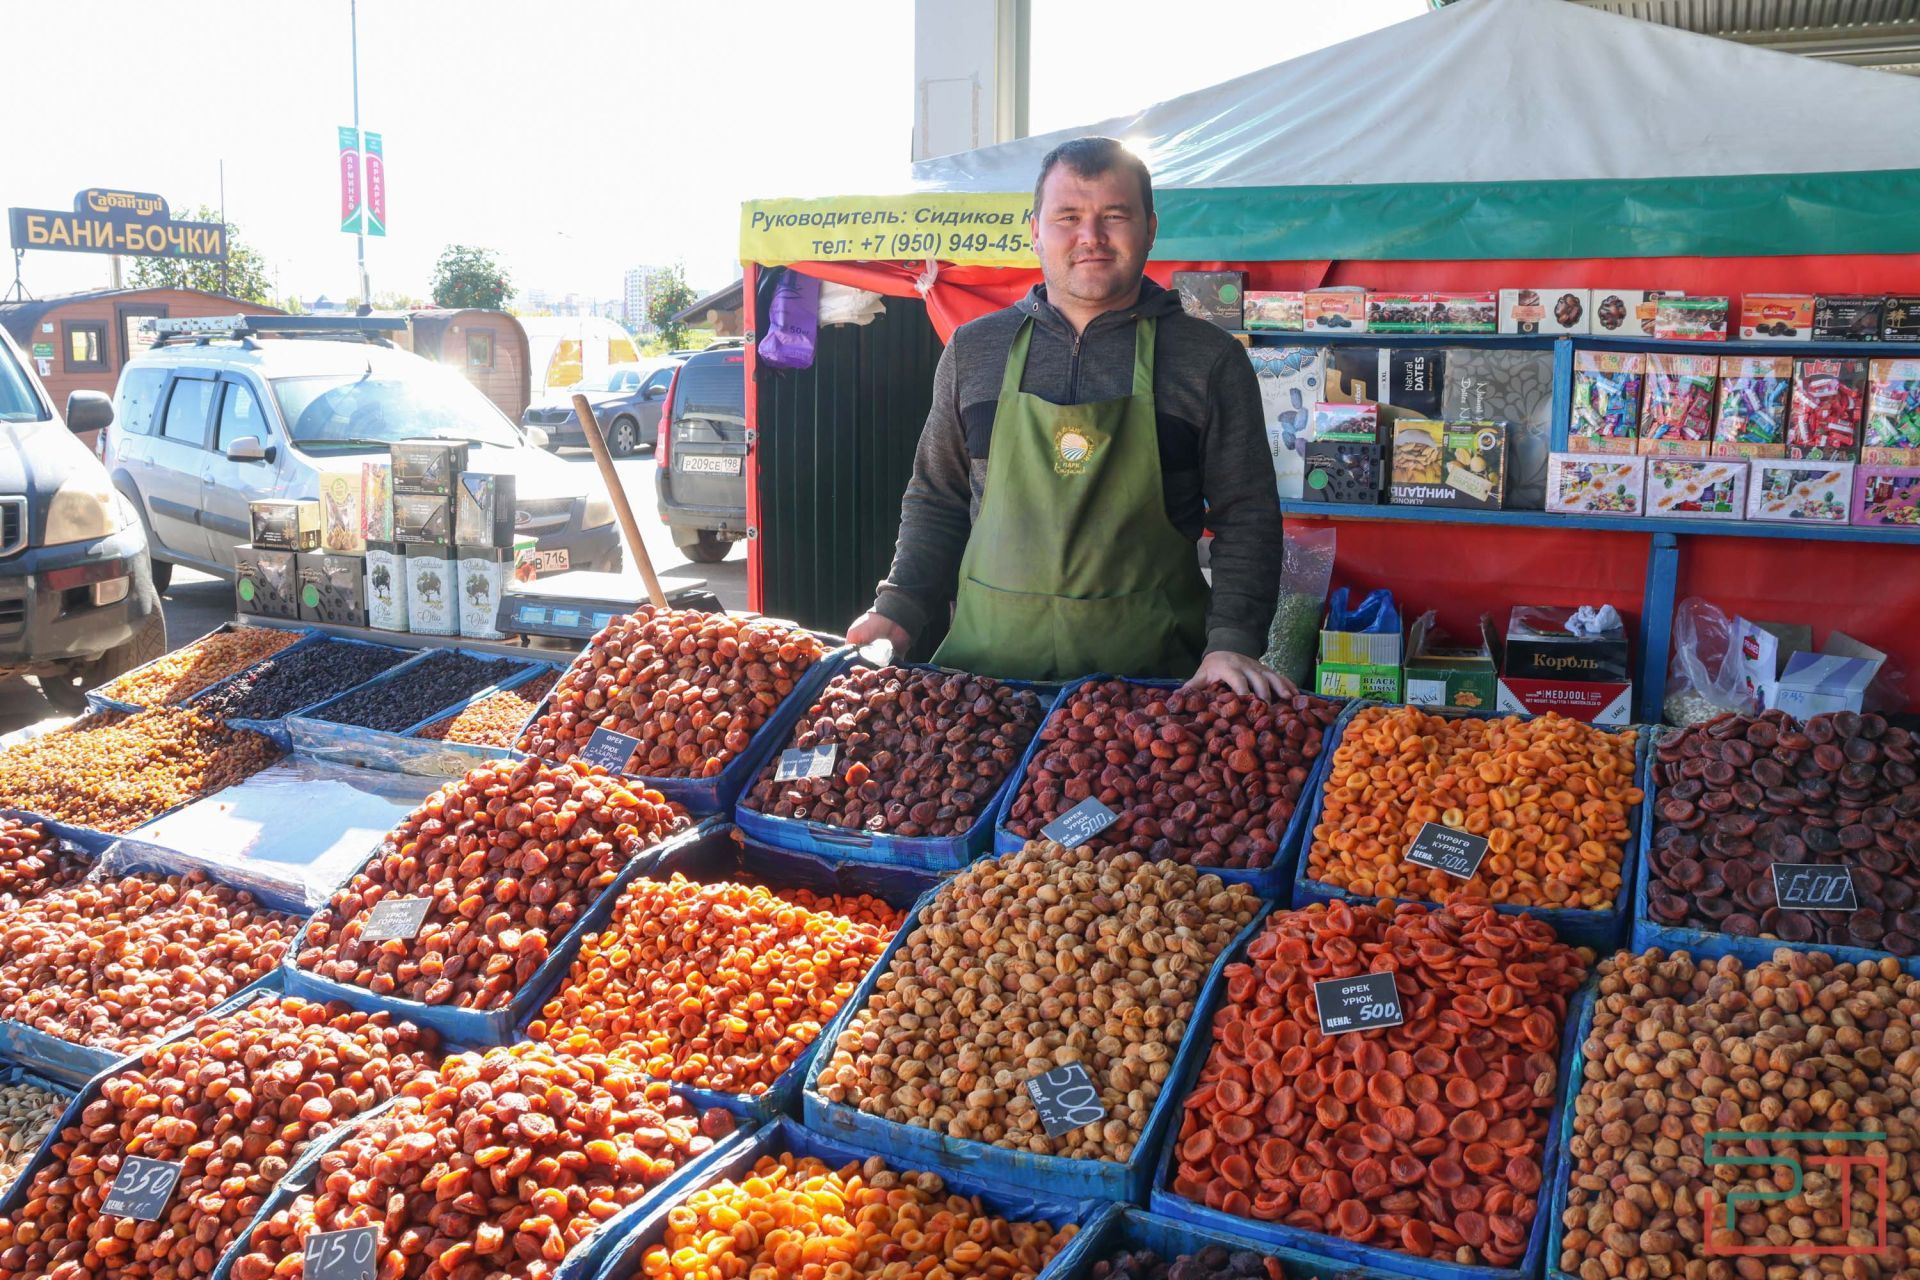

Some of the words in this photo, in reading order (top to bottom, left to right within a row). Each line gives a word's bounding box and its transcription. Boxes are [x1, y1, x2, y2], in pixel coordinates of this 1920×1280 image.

[372, 161, 381, 213] ЯРМАРКА
[87, 191, 163, 216] Сабантуй
[751, 209, 908, 232] Руководитель:
[914, 208, 1014, 226] Сидиков
[27, 215, 221, 255] БАНИ-БОЧКИ
[812, 239, 853, 255] тел:
[860, 235, 884, 253] +7
[890, 232, 942, 257] (950)
[949, 232, 1034, 251] 949-45-
[1404, 361, 1414, 391] Natural
[1414, 356, 1425, 391] DATES
[724, 458, 738, 468] 198
[1390, 485, 1456, 499] МИНДАЛЬ
[545, 552, 565, 565] 716
[1533, 653, 1599, 671] Король
[1363, 677, 1396, 685] BLACK
[1545, 690, 1586, 700] MEDJOOL
[1610, 705, 1627, 719] LARGE
[1067, 814, 1091, 831] УРЮК
[1412, 849, 1434, 861] ЦЕНА:
[1431, 840, 1466, 856] КУРЯГА
[1783, 873, 1849, 903] 600
[1341, 983, 1370, 995] ӨРЕК
[1342, 994, 1374, 1007] УРЮК
[1326, 1015, 1352, 1028] ЦЕНА:
[306, 1231, 373, 1273] 450
